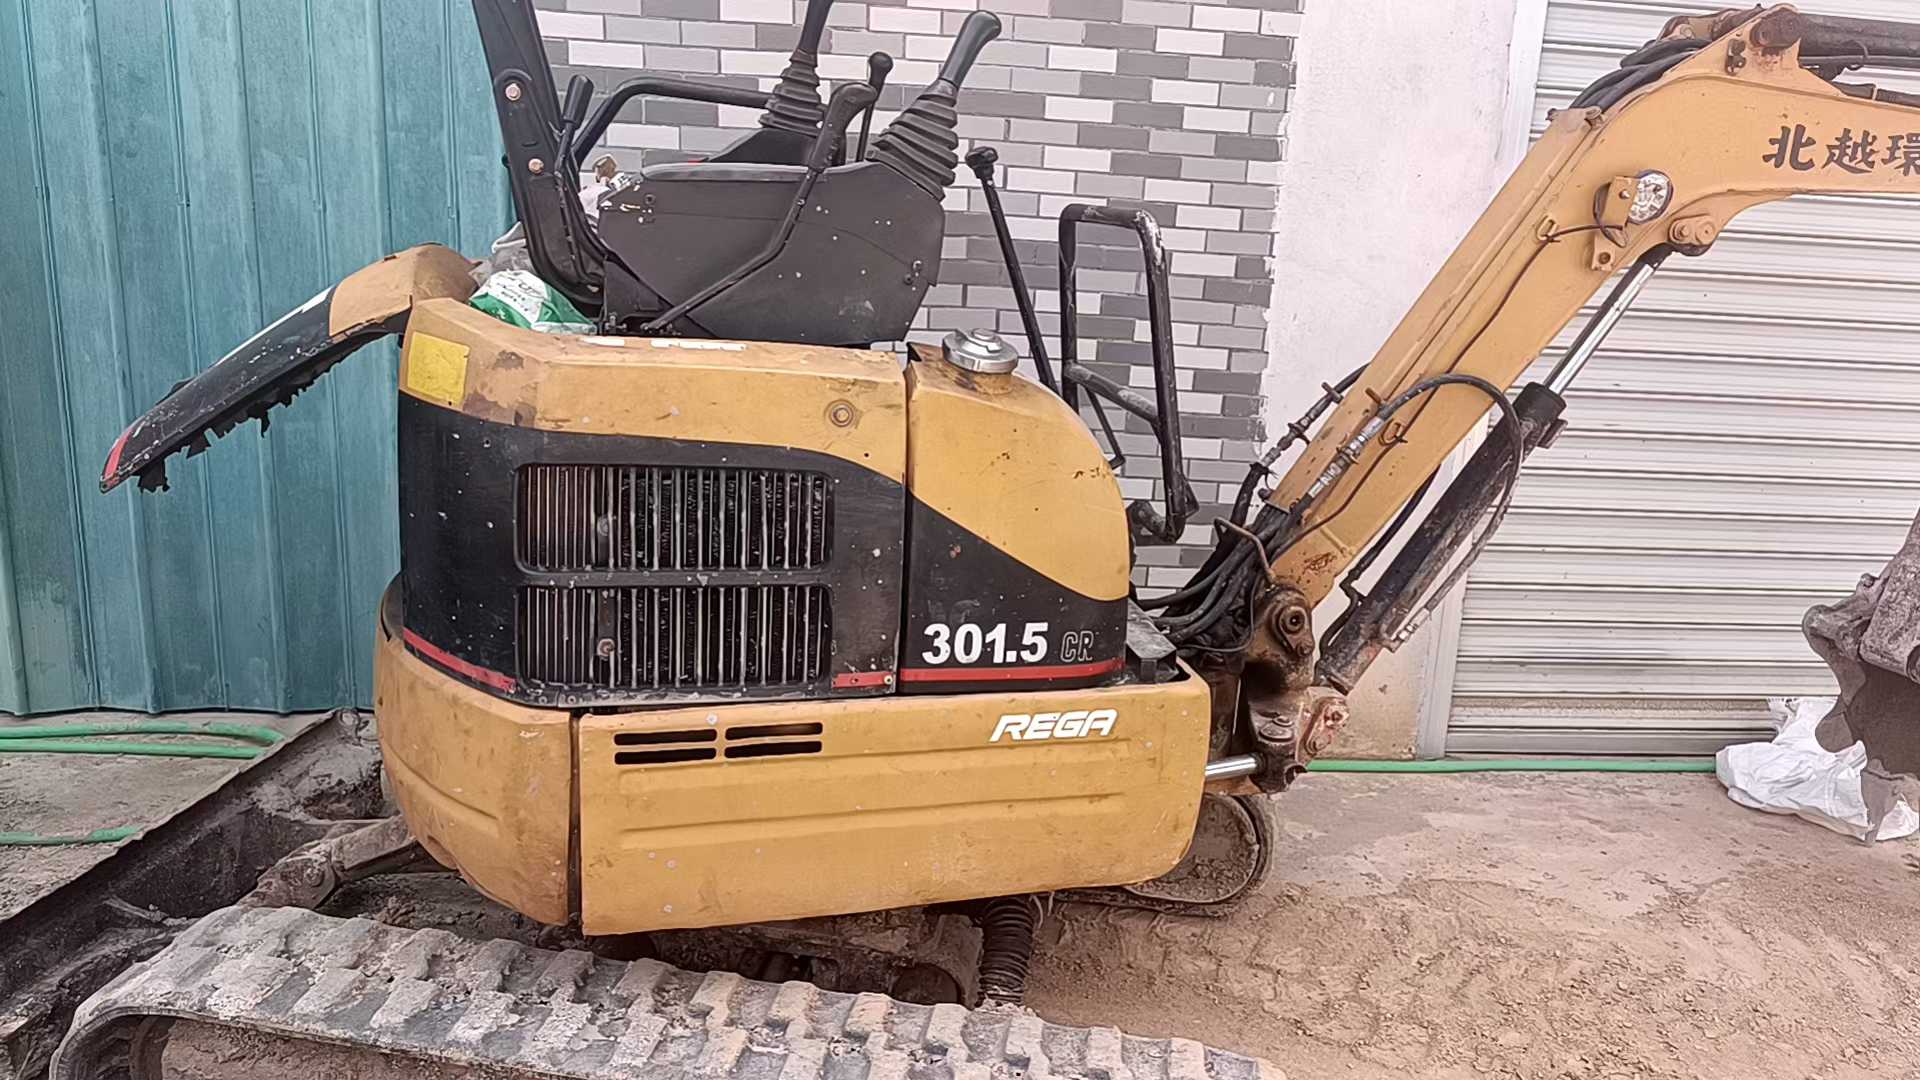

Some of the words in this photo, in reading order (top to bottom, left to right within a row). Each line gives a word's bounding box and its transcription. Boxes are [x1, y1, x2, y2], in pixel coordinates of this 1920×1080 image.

[1762, 124, 1920, 176] 北越環
[922, 622, 1049, 664] 301.5
[1060, 631, 1094, 662] CR
[989, 709, 1118, 742] REGA
